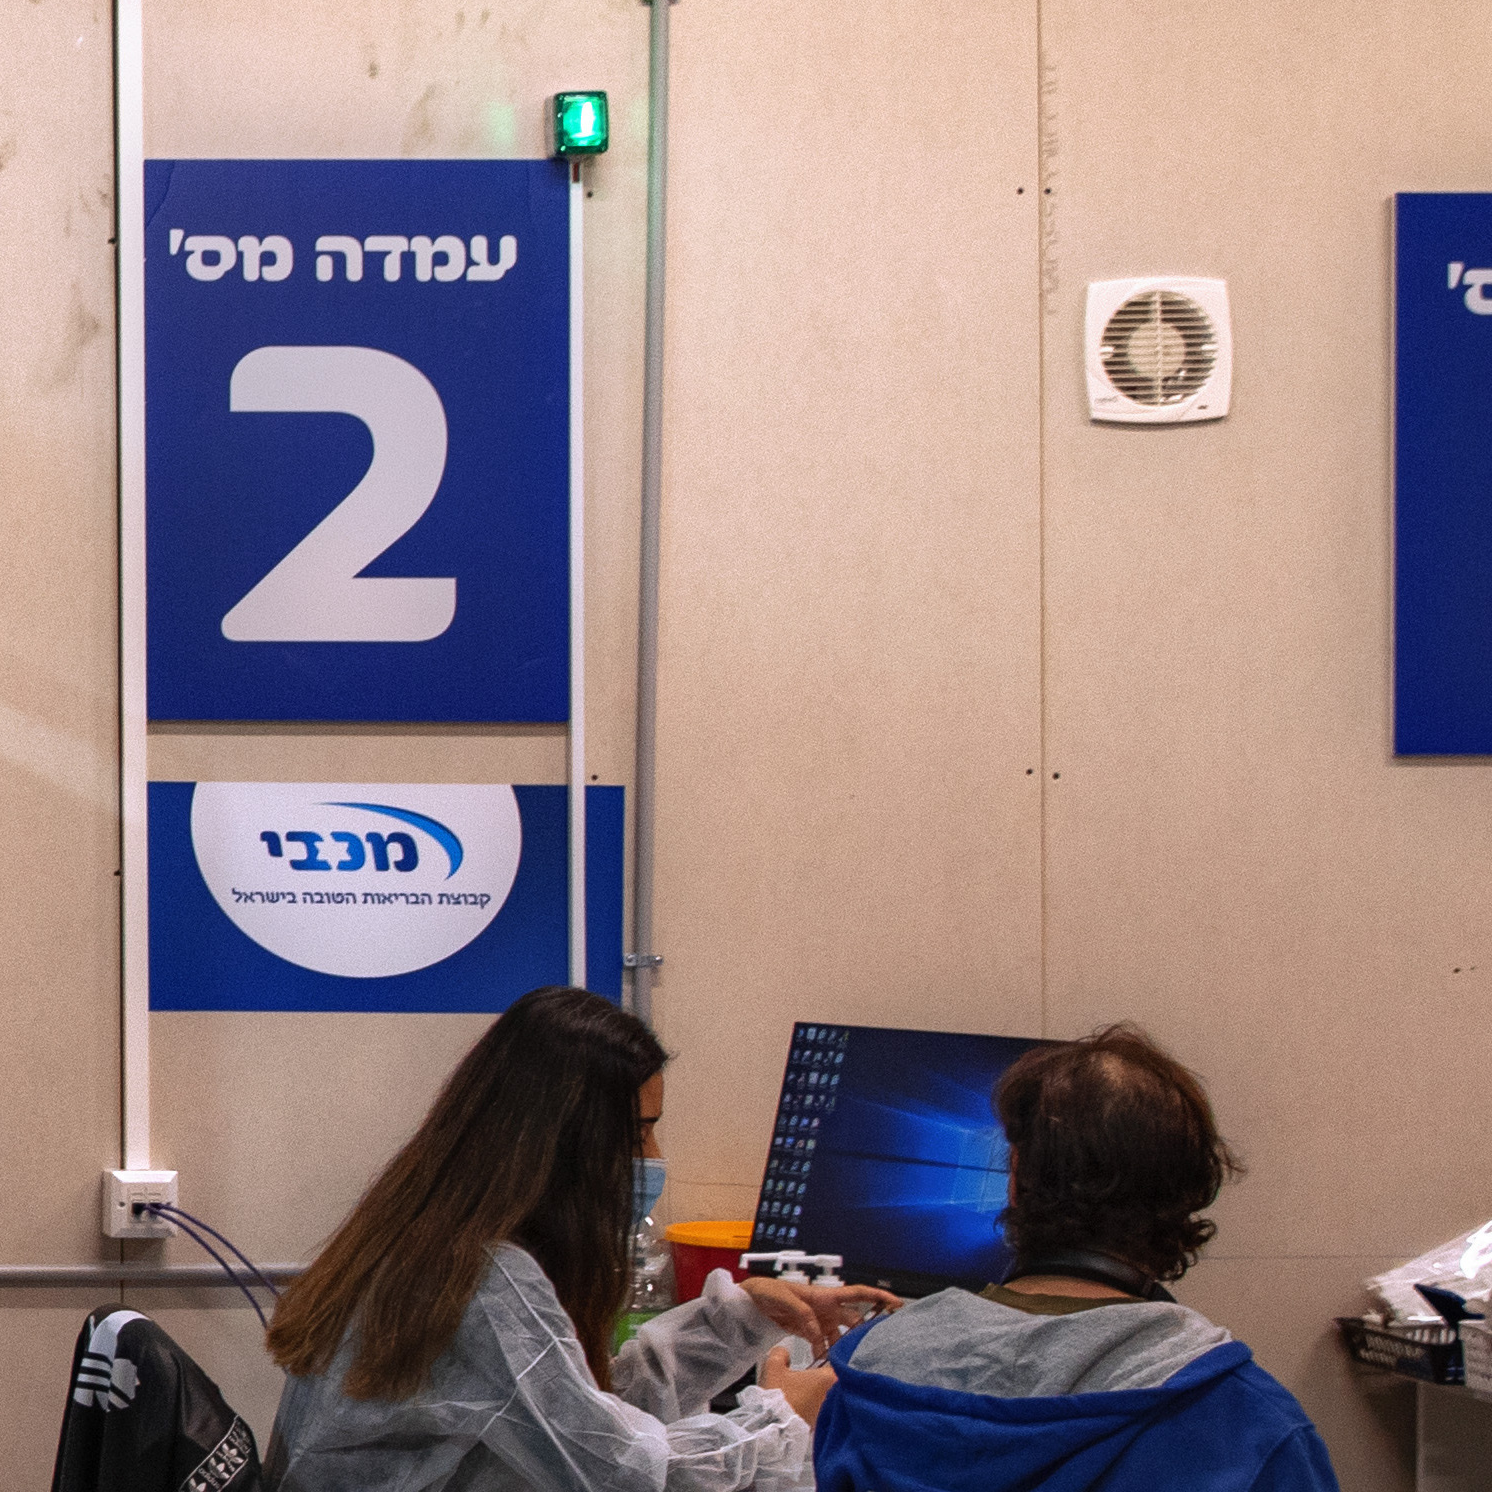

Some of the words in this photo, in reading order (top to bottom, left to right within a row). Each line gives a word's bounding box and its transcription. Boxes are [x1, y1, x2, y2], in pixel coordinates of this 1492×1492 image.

[170, 229, 293, 282] מס'
[316, 236, 517, 282] עמדה
[221, 345, 457, 642] 2
[260, 830, 418, 872] מכבי
[231, 888, 298, 905] בישראל
[302, 892, 357, 905] הטובה
[361, 892, 433, 905] הבריאות
[438, 892, 492, 910] קבוצת
